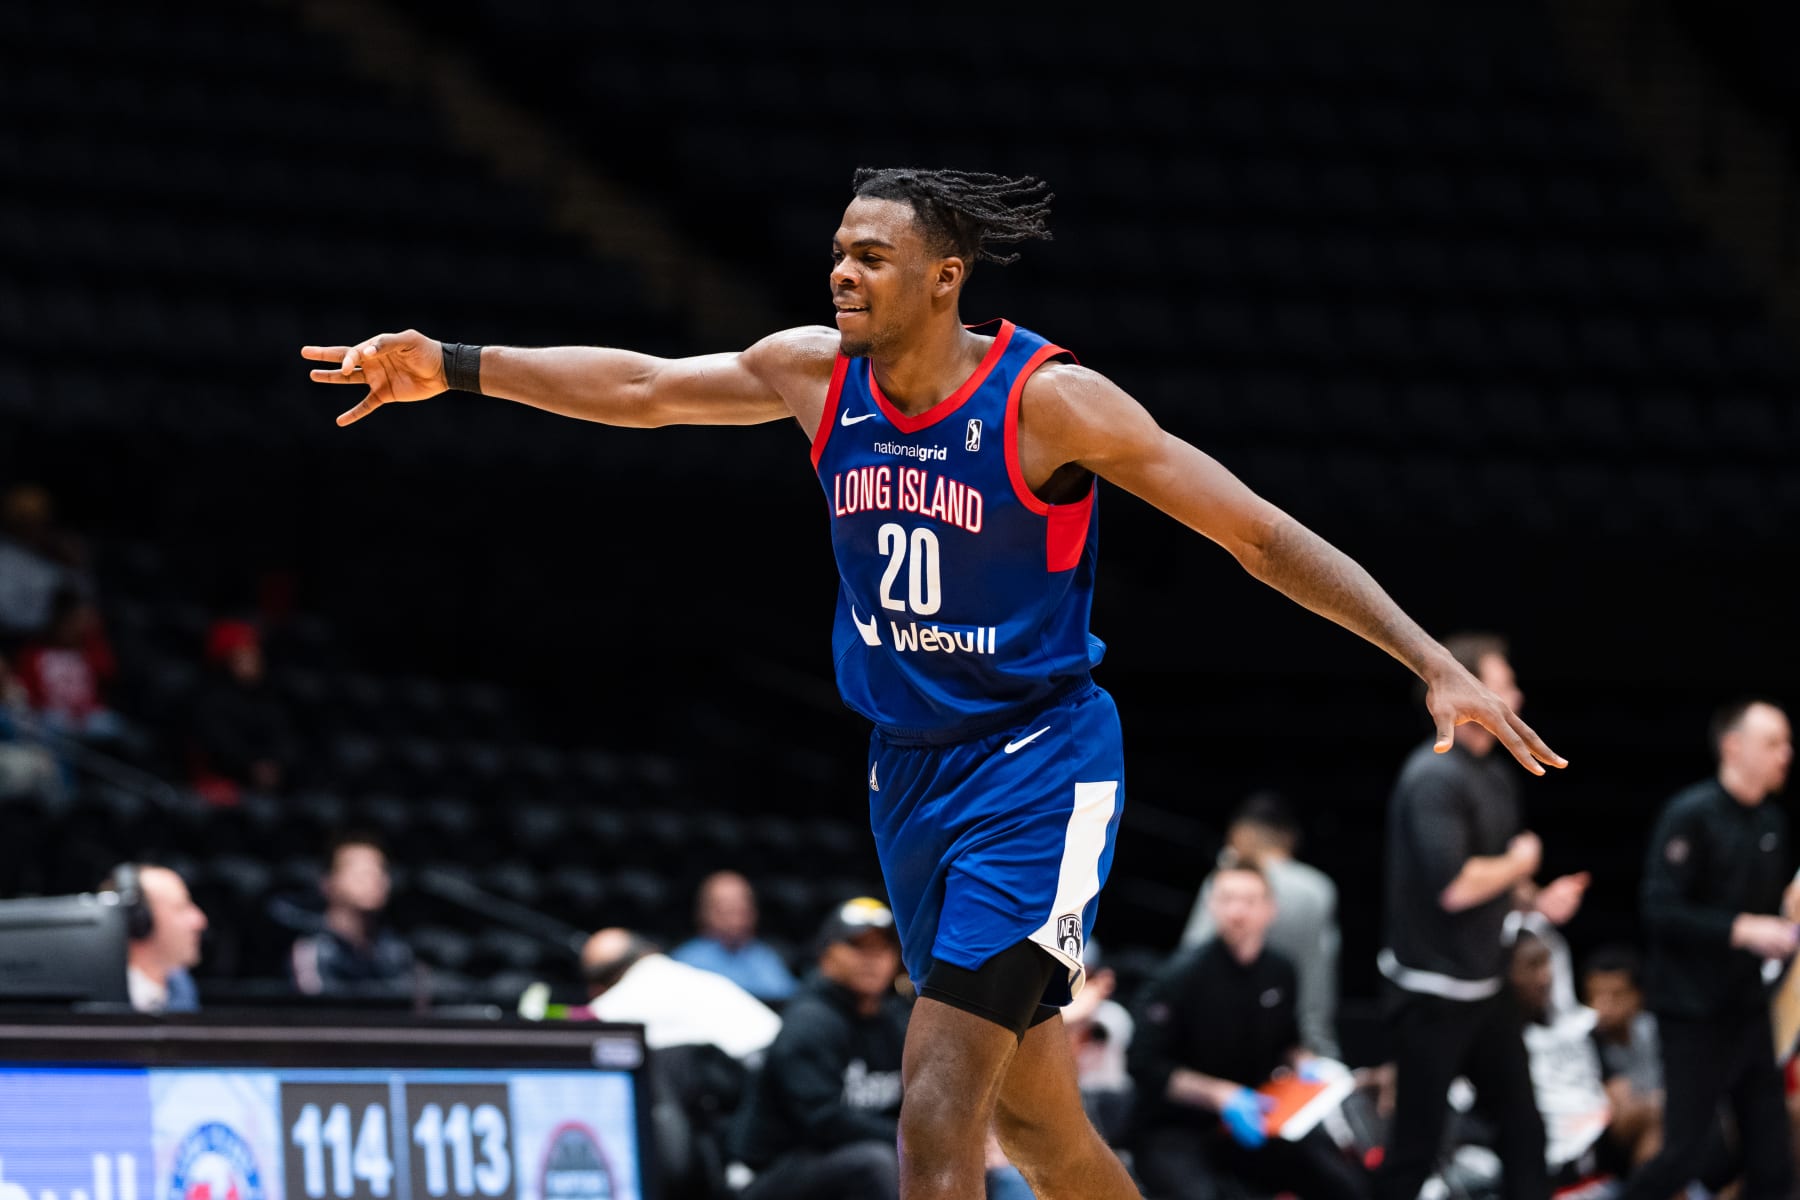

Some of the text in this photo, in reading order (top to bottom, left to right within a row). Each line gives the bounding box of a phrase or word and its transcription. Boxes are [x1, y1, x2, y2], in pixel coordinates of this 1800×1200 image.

[874, 441, 947, 461] nationalgrid
[834, 465, 984, 534] LONG ISLAND
[877, 522, 942, 616] 20
[890, 621, 996, 654] Webull
[1060, 919, 1081, 939] NETS
[291, 1102, 395, 1199] 114
[413, 1102, 512, 1198] 113
